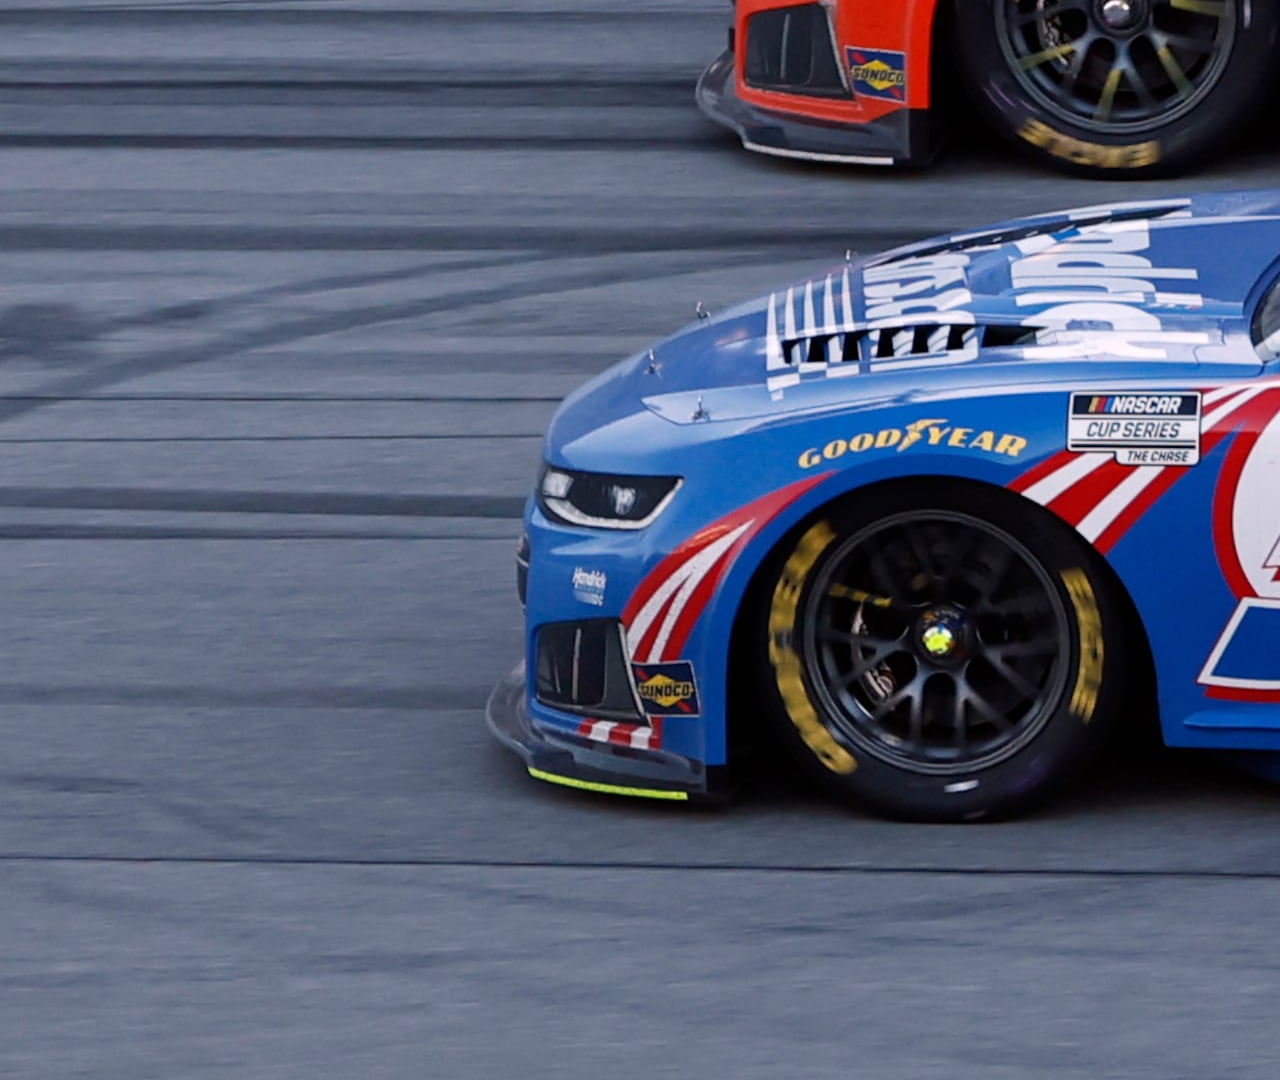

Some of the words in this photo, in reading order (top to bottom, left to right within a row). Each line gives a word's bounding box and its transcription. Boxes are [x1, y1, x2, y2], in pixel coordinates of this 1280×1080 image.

[853, 67, 904, 84] SUNOCO
[1110, 396, 1183, 414] NASCAR
[1086, 422, 1122, 438] CUP
[1122, 422, 1181, 439] SERIES
[797, 419, 1028, 469] GOODYEAR
[1126, 450, 1150, 462] THE
[1151, 450, 1190, 462] CHASE
[639, 683, 691, 697] SUNOCO
